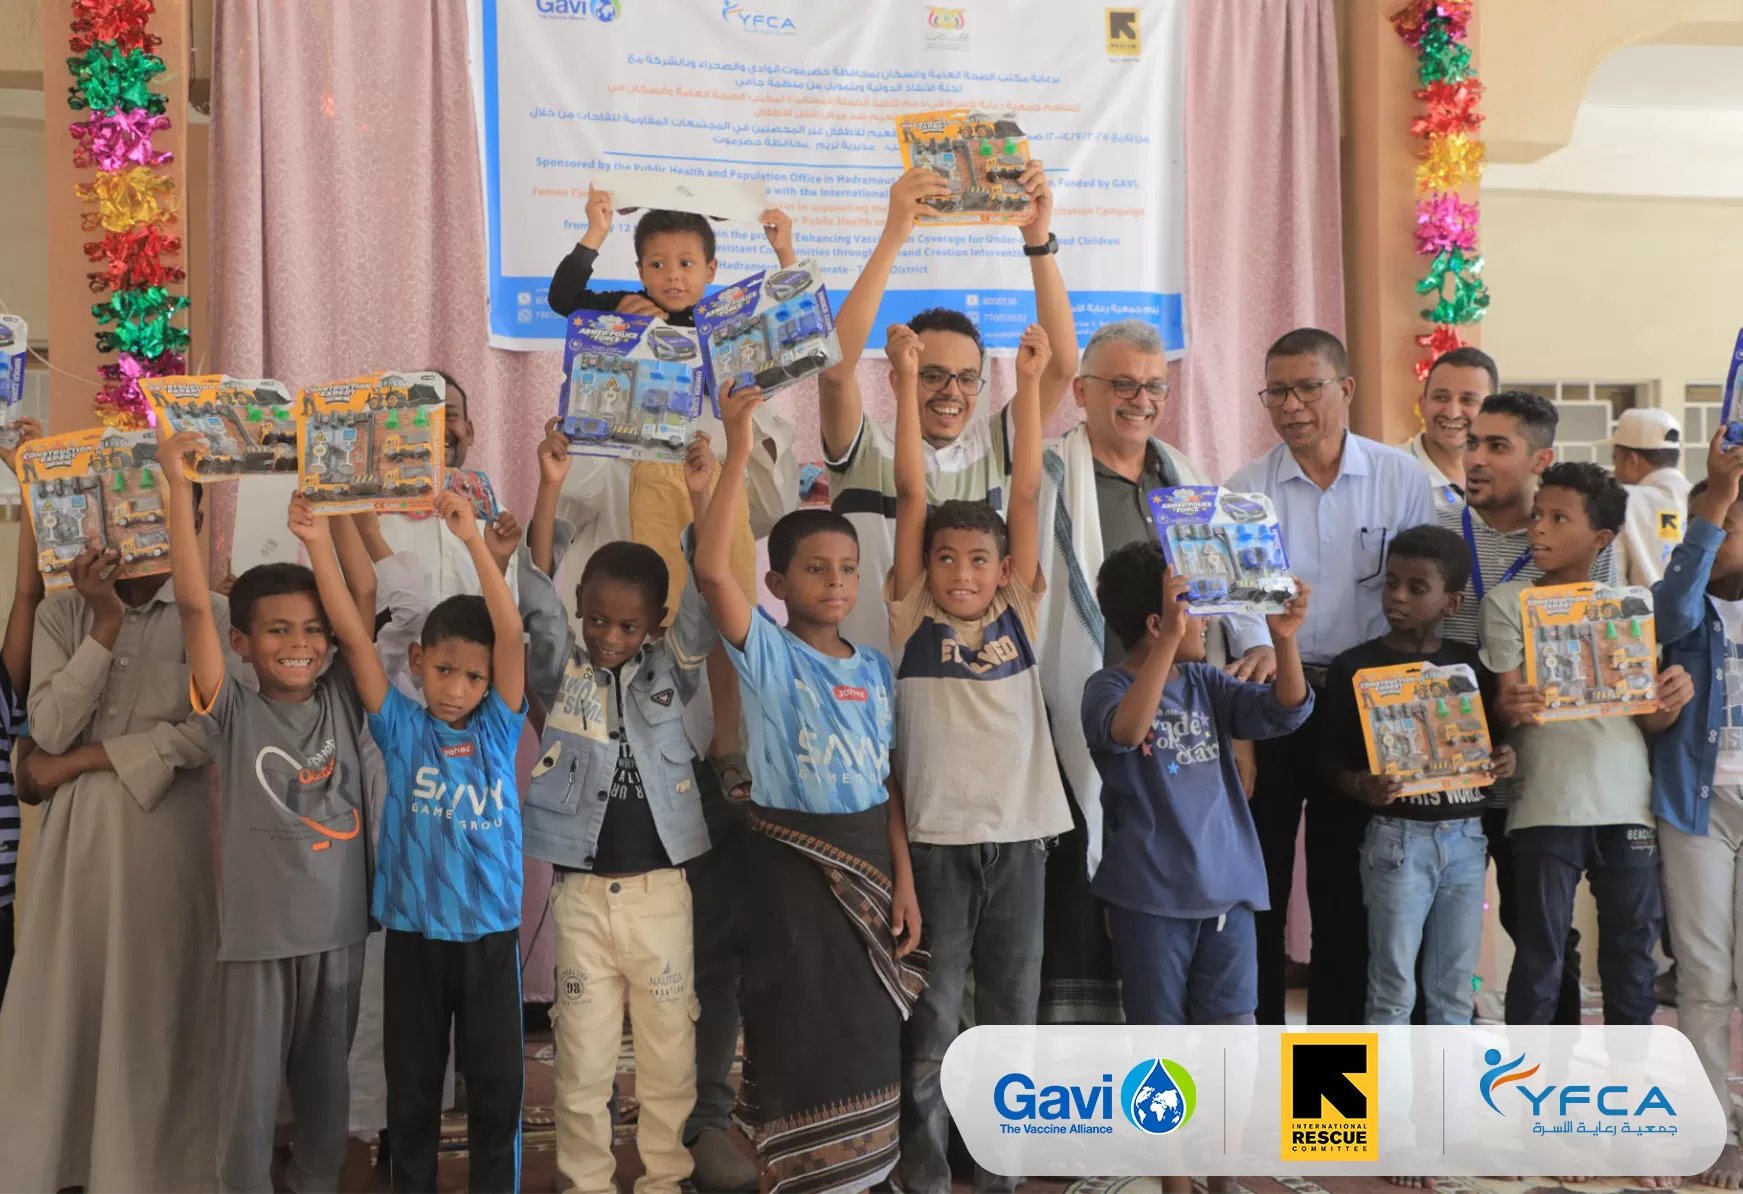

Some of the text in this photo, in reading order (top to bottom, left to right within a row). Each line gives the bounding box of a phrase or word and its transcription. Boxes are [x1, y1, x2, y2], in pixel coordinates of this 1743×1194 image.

[738, 13, 796, 30] YFCA
[627, 53, 644, 65] مع
[535, 157, 595, 171] Sponsored
[598, 159, 611, 173] by
[614, 162, 631, 171] the
[669, 165, 705, 178] Health
[708, 168, 727, 179] and
[730, 169, 787, 185] Population
[790, 172, 821, 184] Office
[823, 173, 834, 184] in
[837, 173, 895, 186] Hadramout
[1058, 178, 1096, 189] Funded
[1098, 178, 1110, 190] by
[774, 185, 889, 200] with the International
[618, 223, 631, 233] 12
[730, 229, 748, 239] the
[917, 233, 967, 246] Coverage
[968, 234, 985, 244] for
[1077, 236, 1120, 246] Children
[716, 244, 757, 254] esistant
[923, 247, 968, 257] Creation
[578, 327, 640, 340] ARMED POLICE
[23, 445, 93, 460] CONSTRUCTION
[411, 803, 503, 830] GAME GROU
[566, 981, 581, 994] 98
